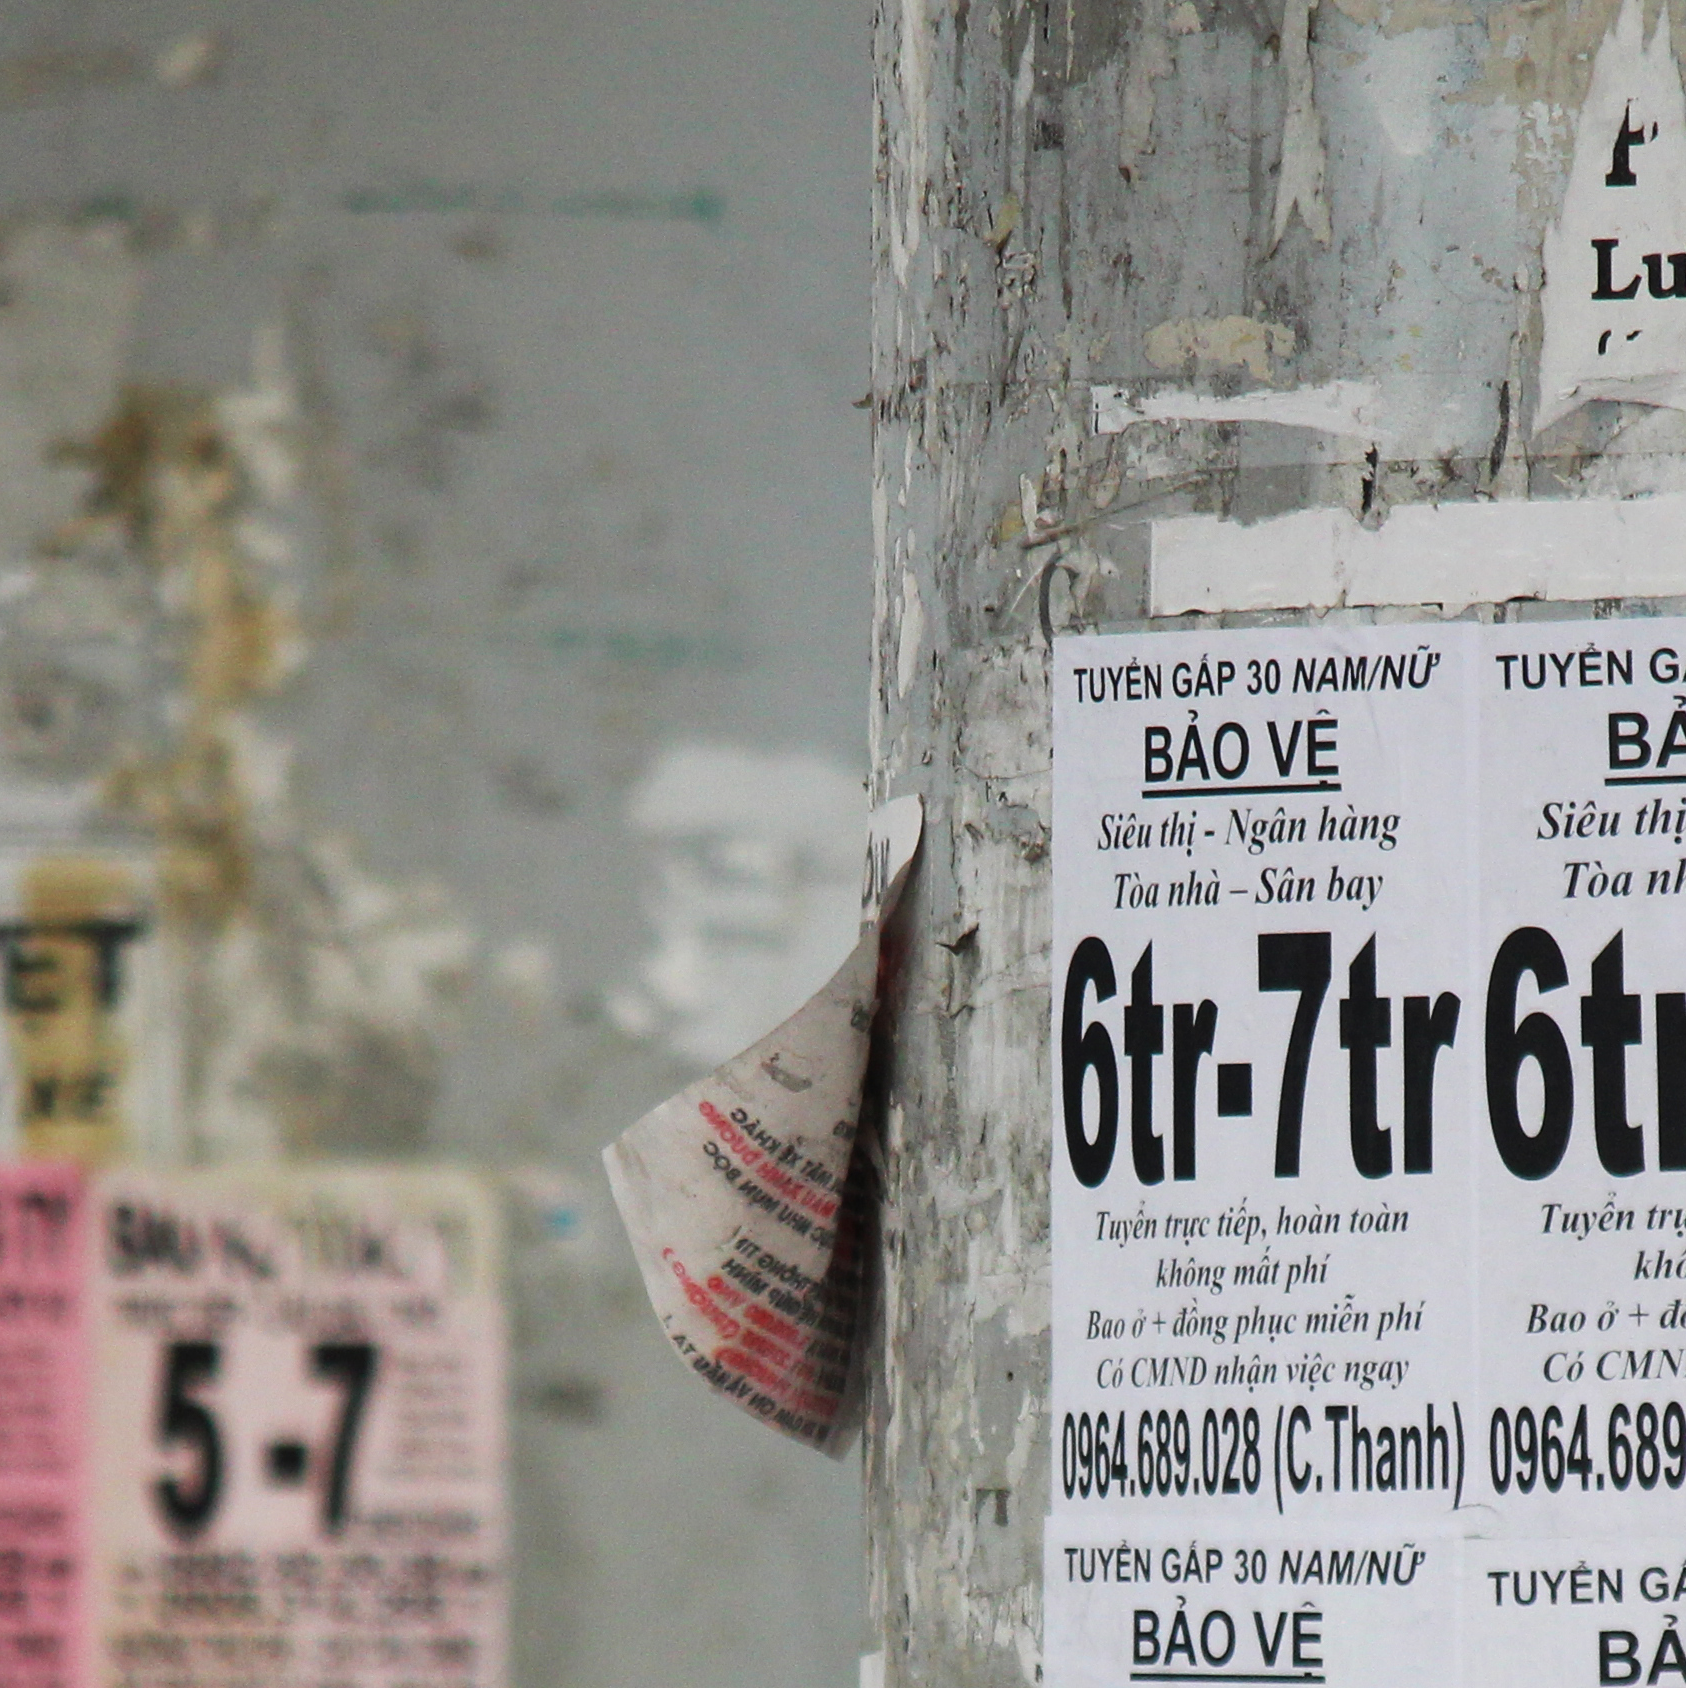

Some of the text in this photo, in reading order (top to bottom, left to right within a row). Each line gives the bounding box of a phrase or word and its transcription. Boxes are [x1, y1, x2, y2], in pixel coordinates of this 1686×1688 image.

[1073, 644, 1441, 704] TUYỂN GẤP 30 NAM/NỮ
[1495, 643, 1633, 691] TUYỂN
[1144, 708, 1339, 784] BẢO VỆ
[1061, 931, 1462, 1189] 6tr-7tr
[1062, 1400, 1465, 1512] 0964.689.028 (C.Thanh)
[1063, 1539, 1427, 1586] TUYỂN GẤP 30 NAM/NỮ
[1487, 1560, 1623, 1606] TUYỂN
[1132, 1595, 1324, 1675] BẢO VỆ
